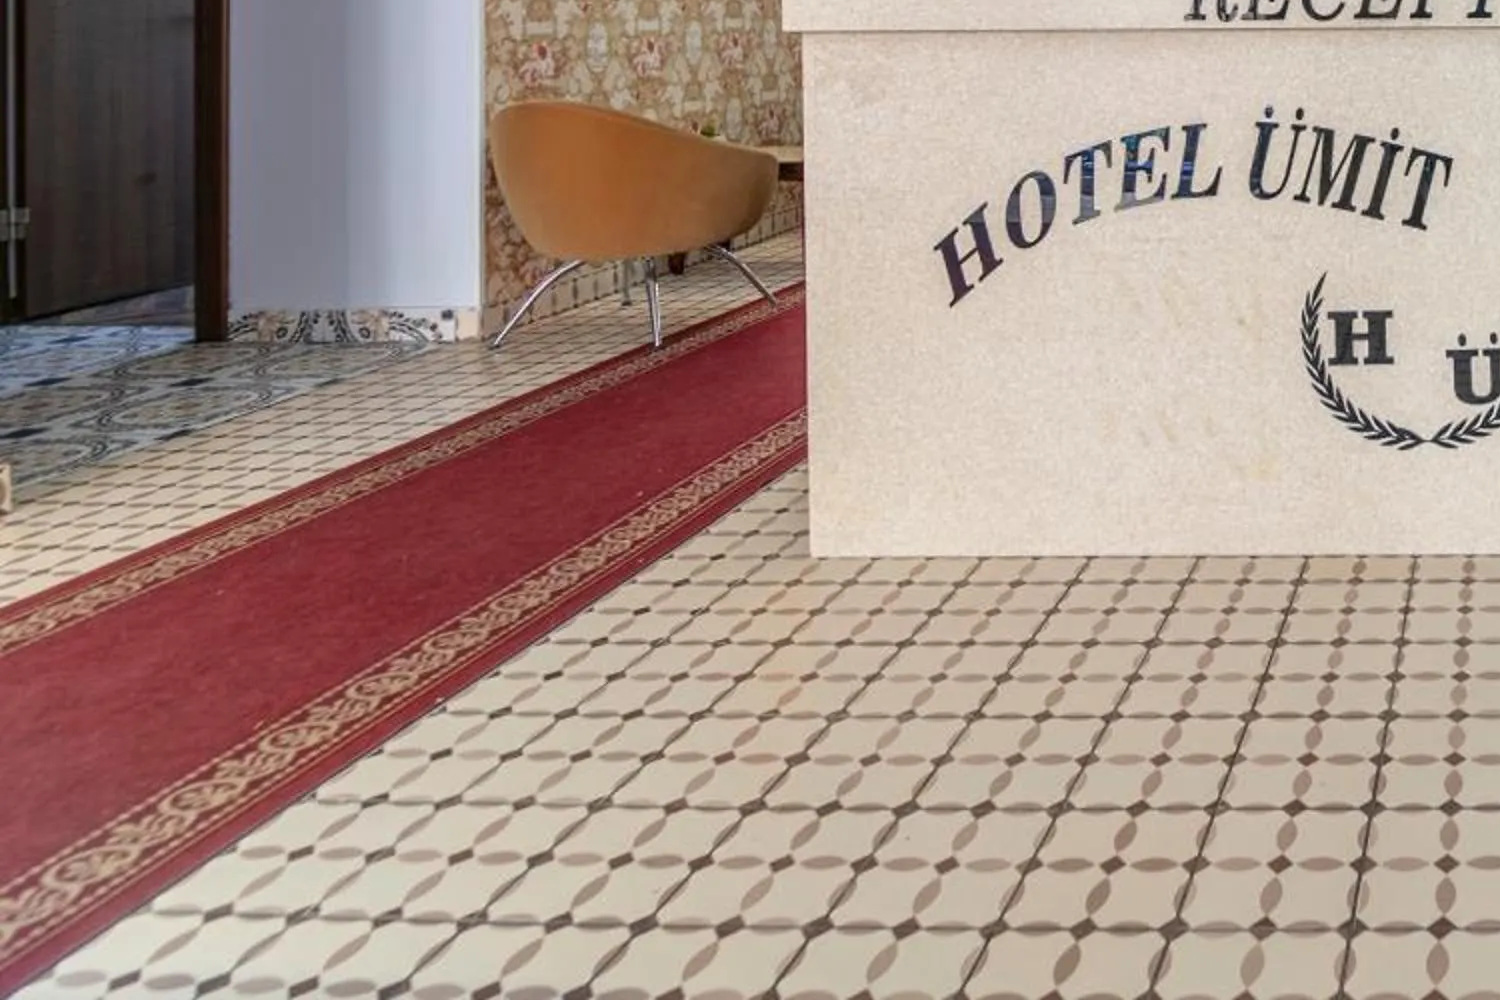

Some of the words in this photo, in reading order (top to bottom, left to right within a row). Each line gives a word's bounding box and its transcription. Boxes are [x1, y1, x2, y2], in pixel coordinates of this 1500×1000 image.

[932, 121, 1224, 309] HOTEL
[1248, 105, 1454, 232] ÜMİT
[1326, 310, 1395, 366] H
